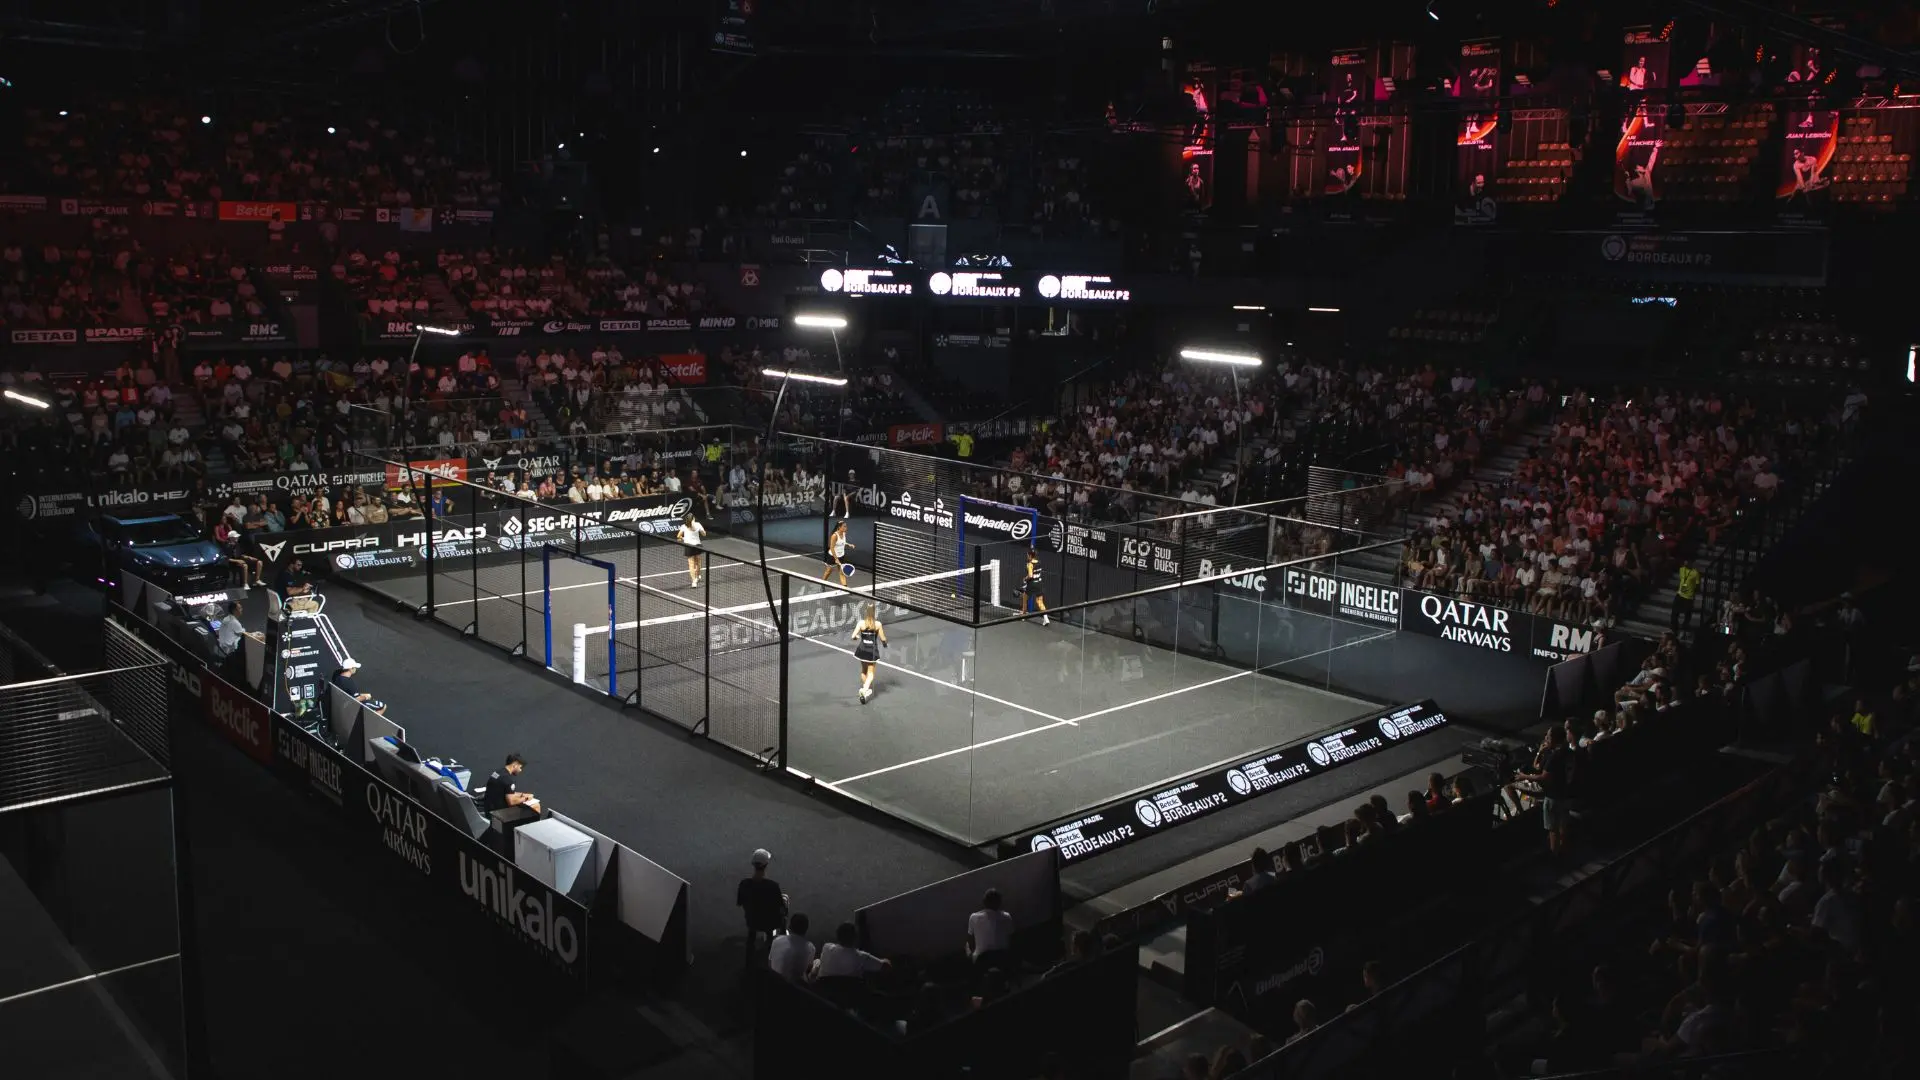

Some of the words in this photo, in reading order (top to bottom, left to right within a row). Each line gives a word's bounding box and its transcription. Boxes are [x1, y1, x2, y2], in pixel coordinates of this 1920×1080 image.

[918, 195, 941, 219] A
[249, 323, 279, 336] RMC
[387, 321, 414, 334] RMC
[517, 454, 561, 471] QATAR
[276, 472, 328, 490] QATAR
[607, 503, 674, 523] Bullpadel
[891, 505, 921, 521] eovest
[964, 512, 1013, 532] Bullpadel
[292, 536, 380, 555] CUPRA
[397, 523, 487, 547] HEAD
[1155, 545, 1171, 560] SUD
[1154, 557, 1180, 575] OUEST
[1309, 575, 1337, 602] CAP
[1340, 581, 1399, 615] INGELEC
[1420, 595, 1510, 634] QATAR
[1441, 625, 1512, 652] AIRWAYS
[1551, 623, 1593, 654] RM
[1533, 647, 1558, 660] INFO
[211, 686, 260, 746] Betclic
[1400, 716, 1437, 737] BORDEAUX
[1435, 713, 1448, 724] P2
[1330, 742, 1371, 763] BORDEAUX
[1369, 736, 1383, 748] P2
[1251, 769, 1299, 791] BORDEAUX
[1297, 762, 1311, 775] P2
[366, 781, 429, 849] QATAR
[1163, 797, 1214, 824] BORDEAUX
[1213, 791, 1228, 804] P2
[1059, 831, 1081, 845] Betclic
[1061, 831, 1120, 860] BORDEAUX
[1119, 824, 1135, 840] P2
[383, 829, 432, 876] AIRWAYS
[1183, 873, 1240, 904] CUPRA
[459, 850, 579, 964] unikalo
